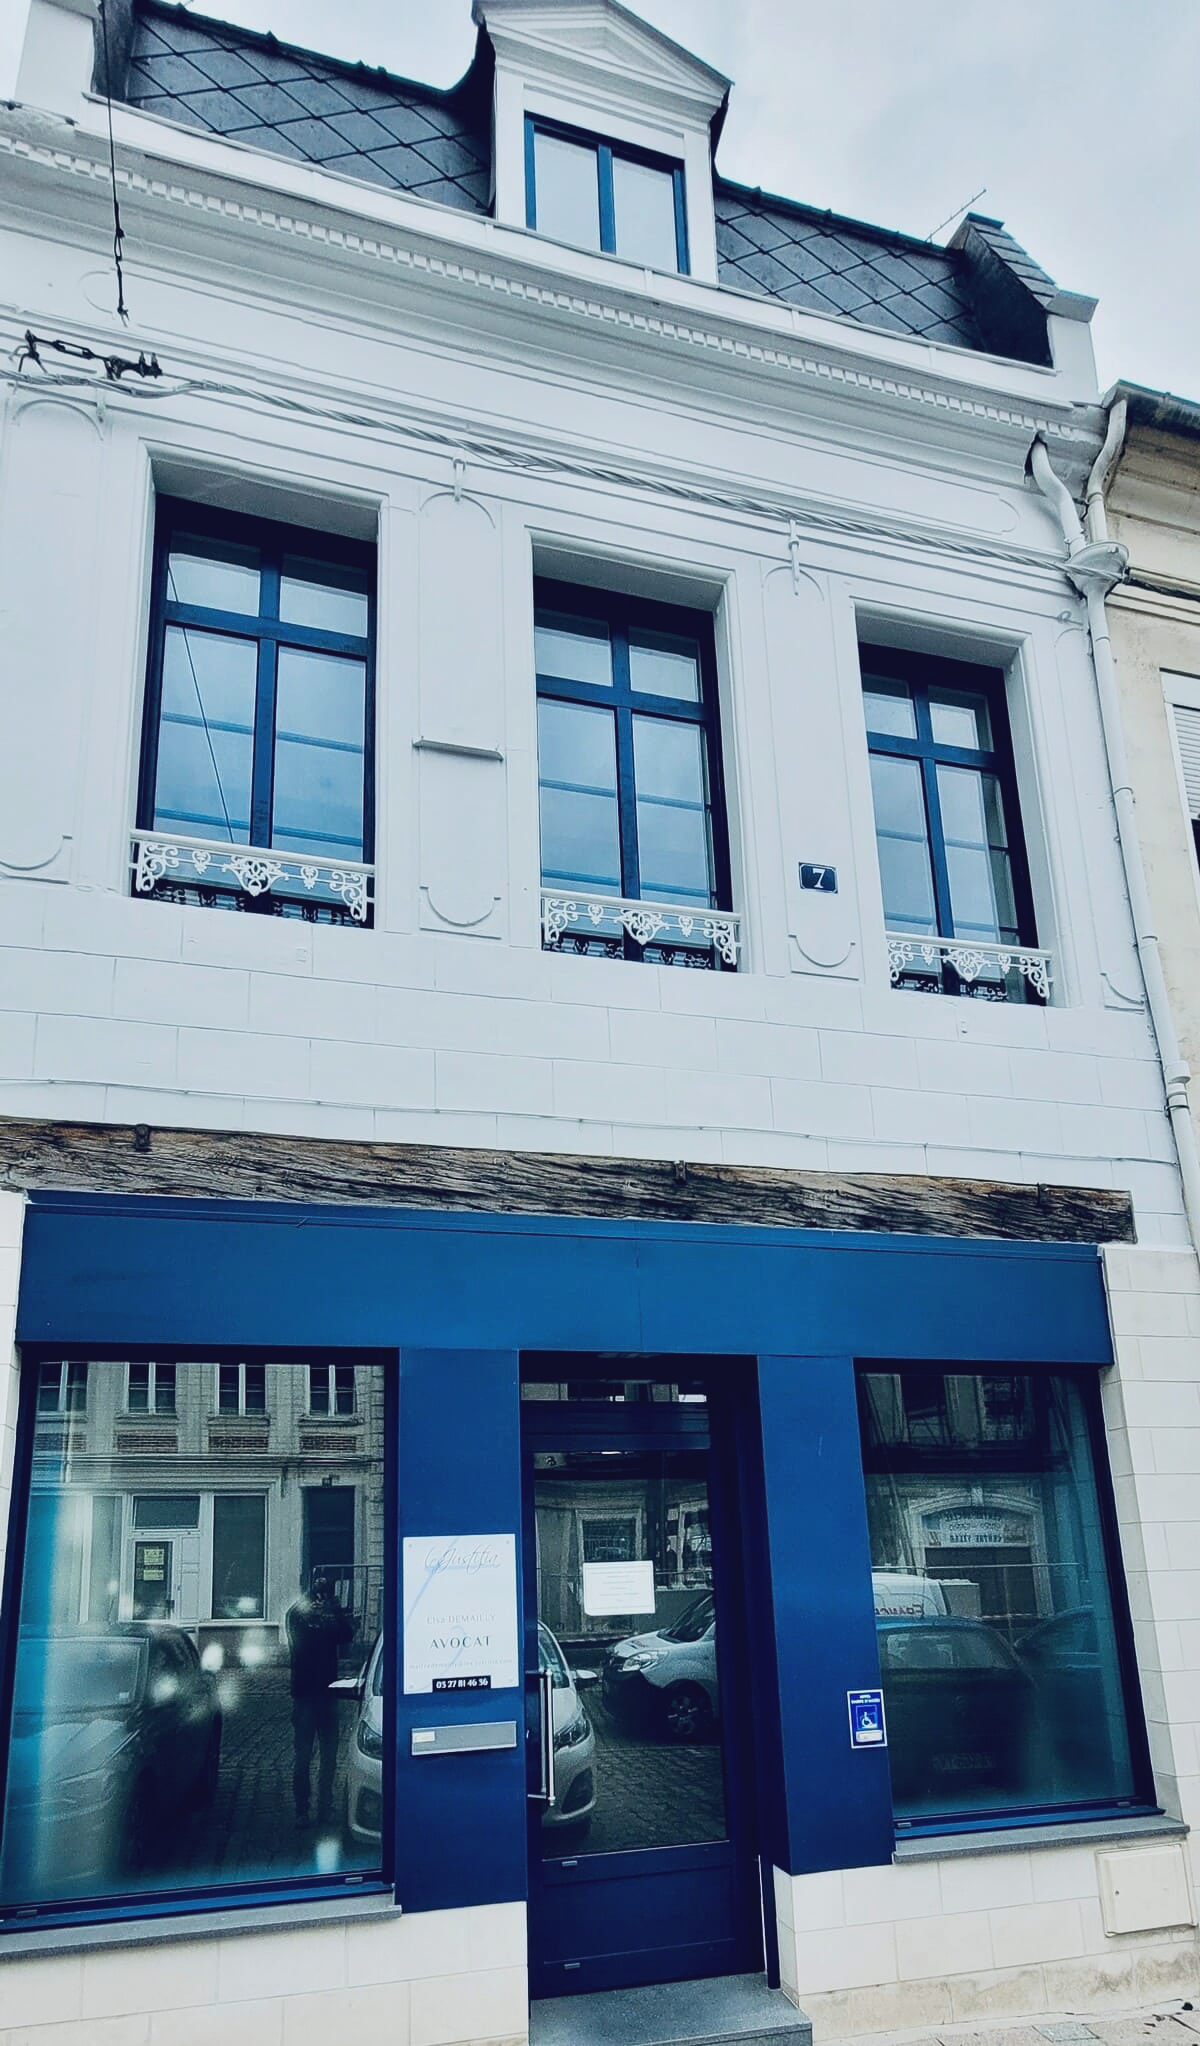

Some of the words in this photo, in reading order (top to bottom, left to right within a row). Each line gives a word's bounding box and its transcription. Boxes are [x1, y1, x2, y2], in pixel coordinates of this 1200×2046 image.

[812, 867, 826, 889] 7
[430, 1635, 491, 1649] AVOCAT
[447, 1679, 457, 1688] 27
[467, 1678, 478, 1687] 46
